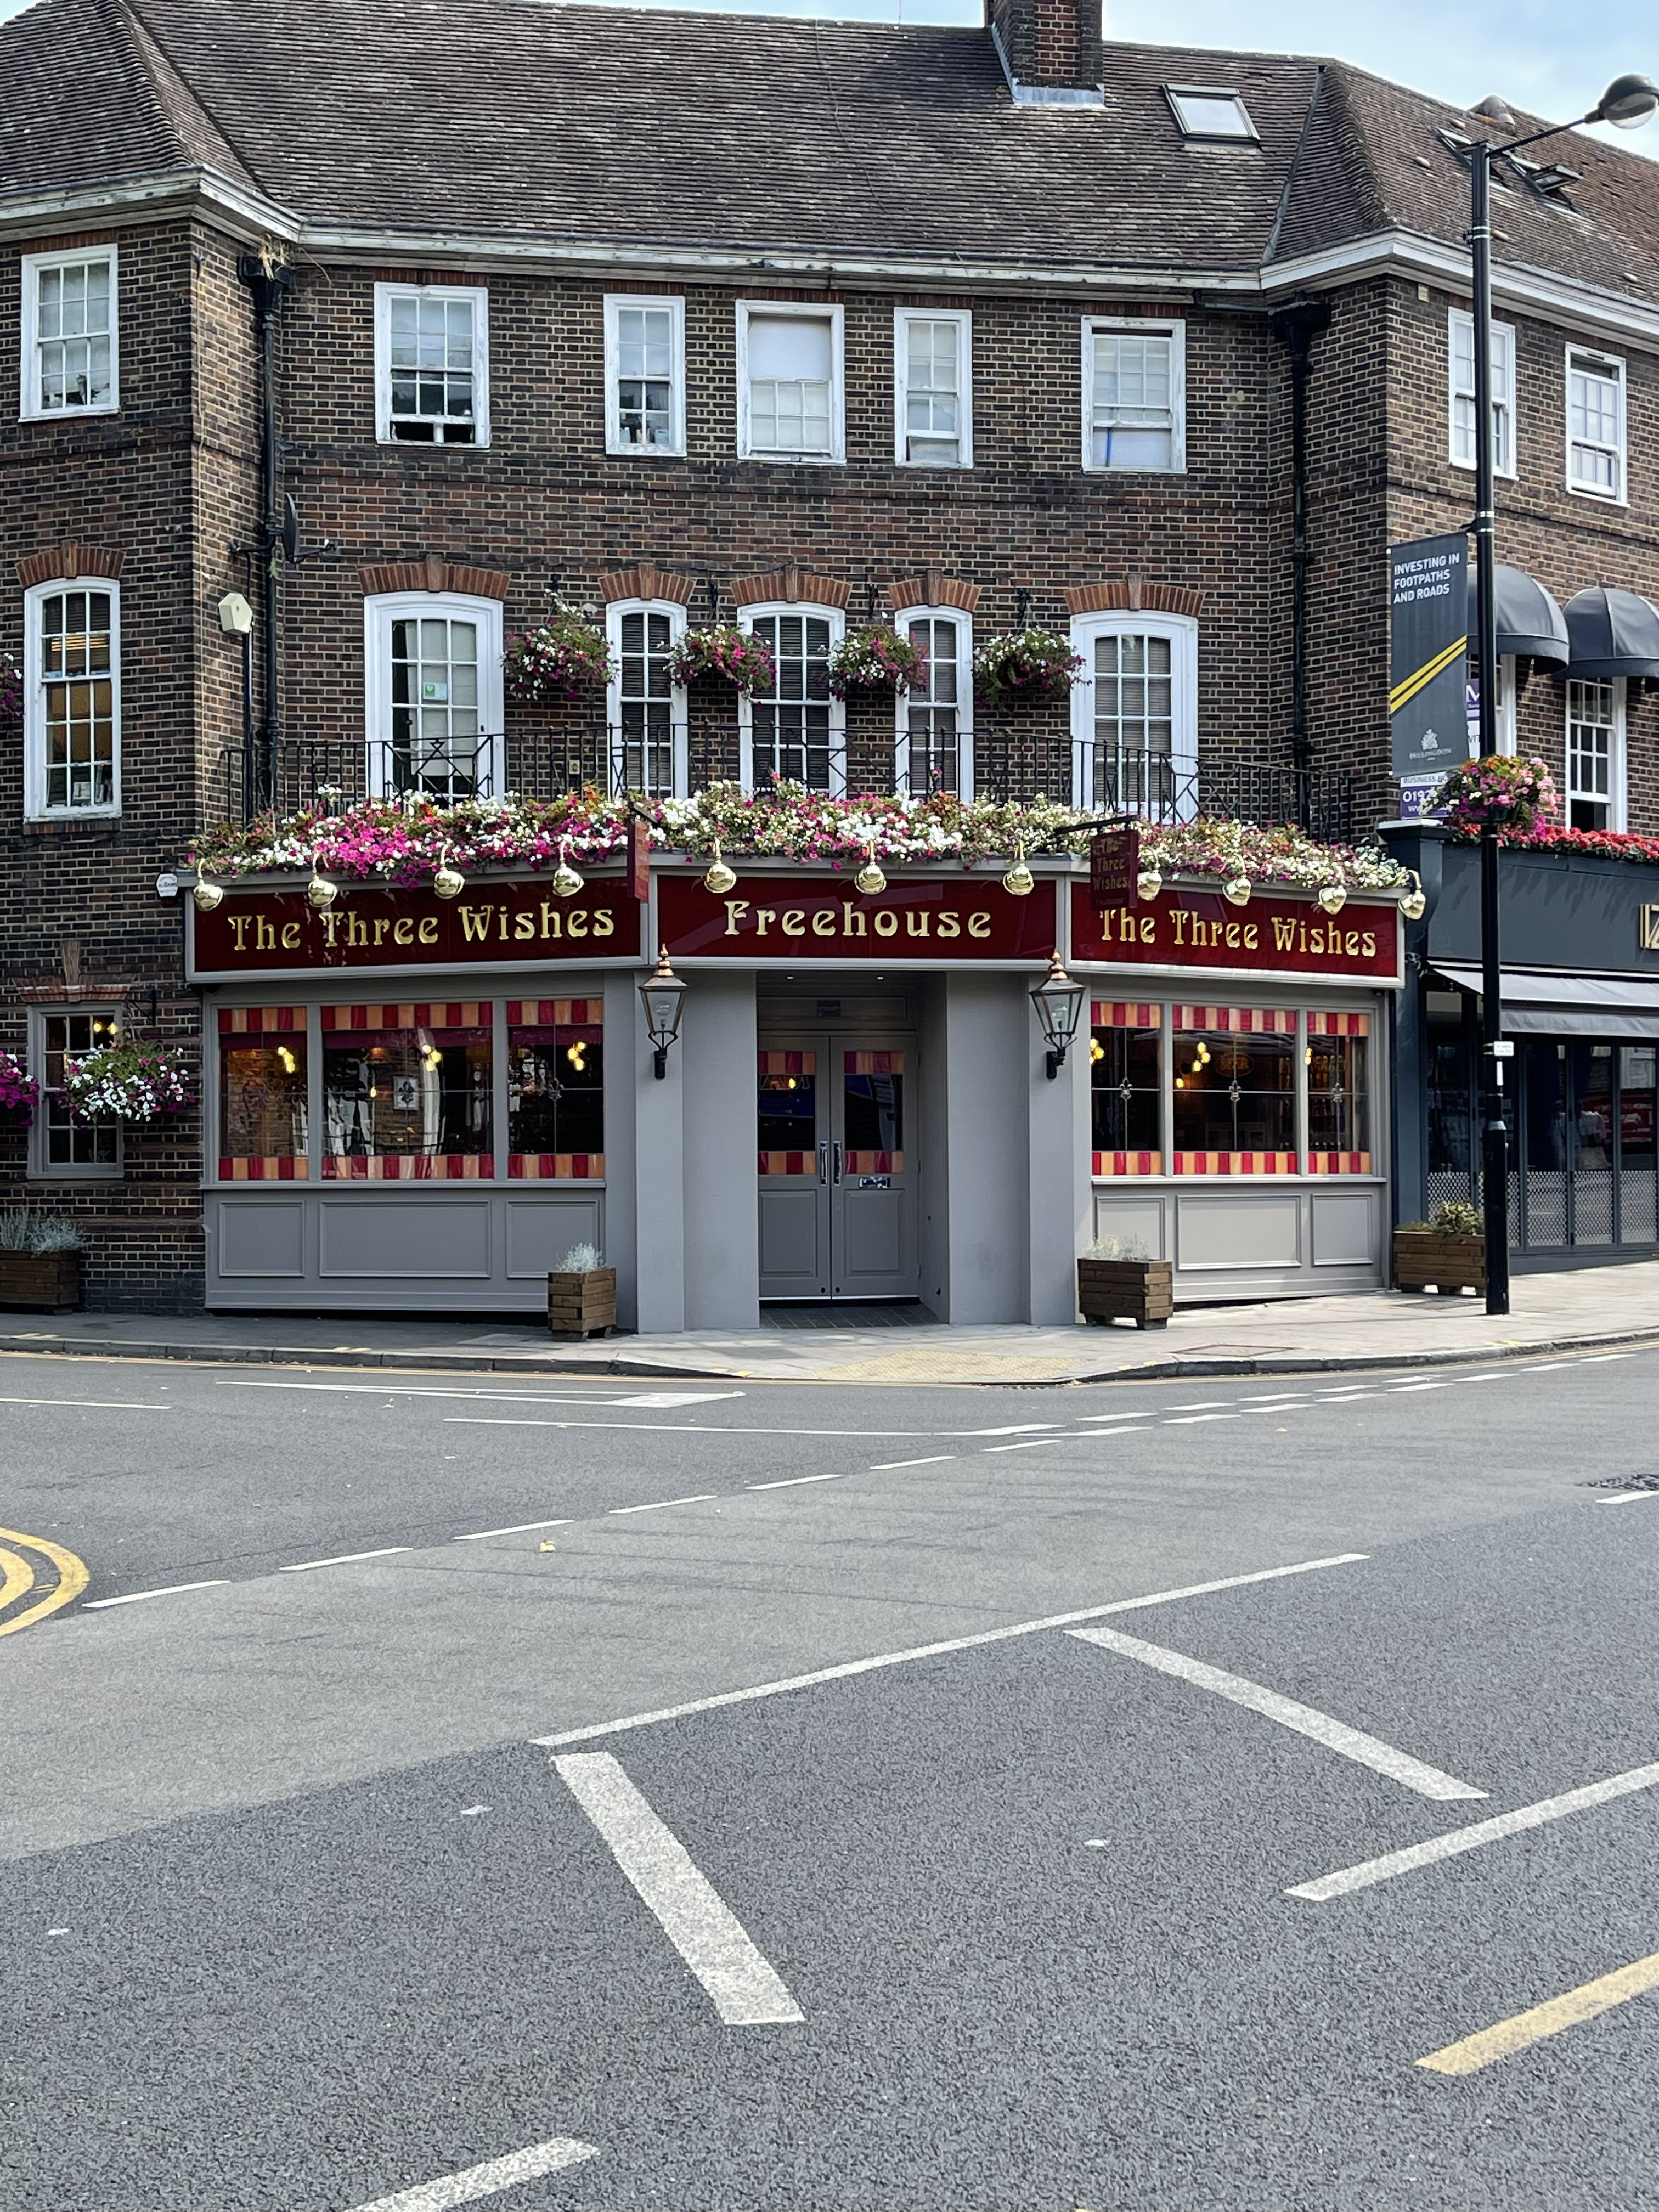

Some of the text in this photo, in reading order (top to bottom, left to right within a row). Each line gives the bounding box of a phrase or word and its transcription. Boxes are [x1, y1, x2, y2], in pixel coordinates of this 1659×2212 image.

[1393, 552, 1460, 575] INVESTING IN
[1393, 568, 1451, 589] FOOTPATHS
[1393, 583, 1450, 604] AND ROADS
[1409, 748, 1452, 760] HILLINGDON
[1096, 857, 1125, 873] Three
[1092, 875, 1128, 891] Wishes
[228, 902, 614, 951] The Three Wishes
[723, 900, 991, 938] Freehouse
[1099, 908, 1376, 958] The Three Wishes
